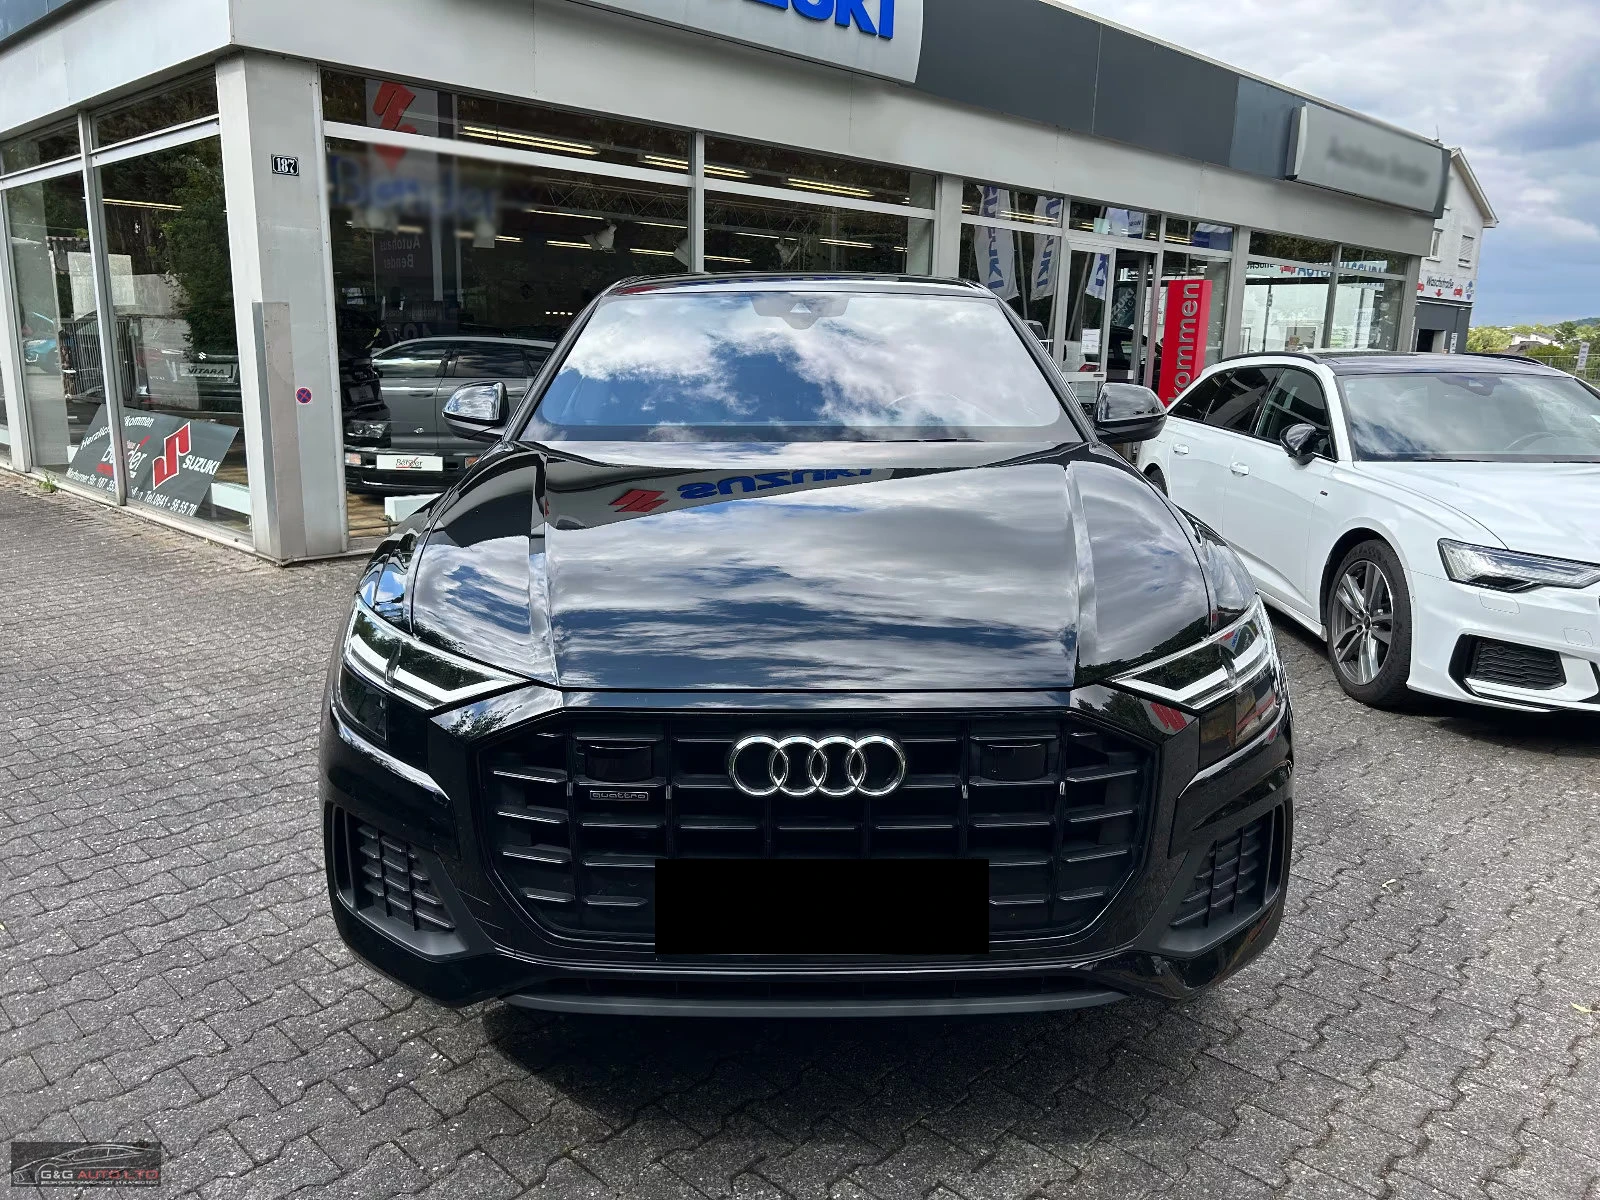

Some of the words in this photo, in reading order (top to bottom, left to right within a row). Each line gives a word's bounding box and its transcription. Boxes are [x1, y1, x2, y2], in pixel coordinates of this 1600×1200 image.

[276, 157, 295, 173] 187
[188, 367, 224, 375] VITARA
[182, 454, 220, 475] SUZUKI
[97, 477, 108, 488] 187
